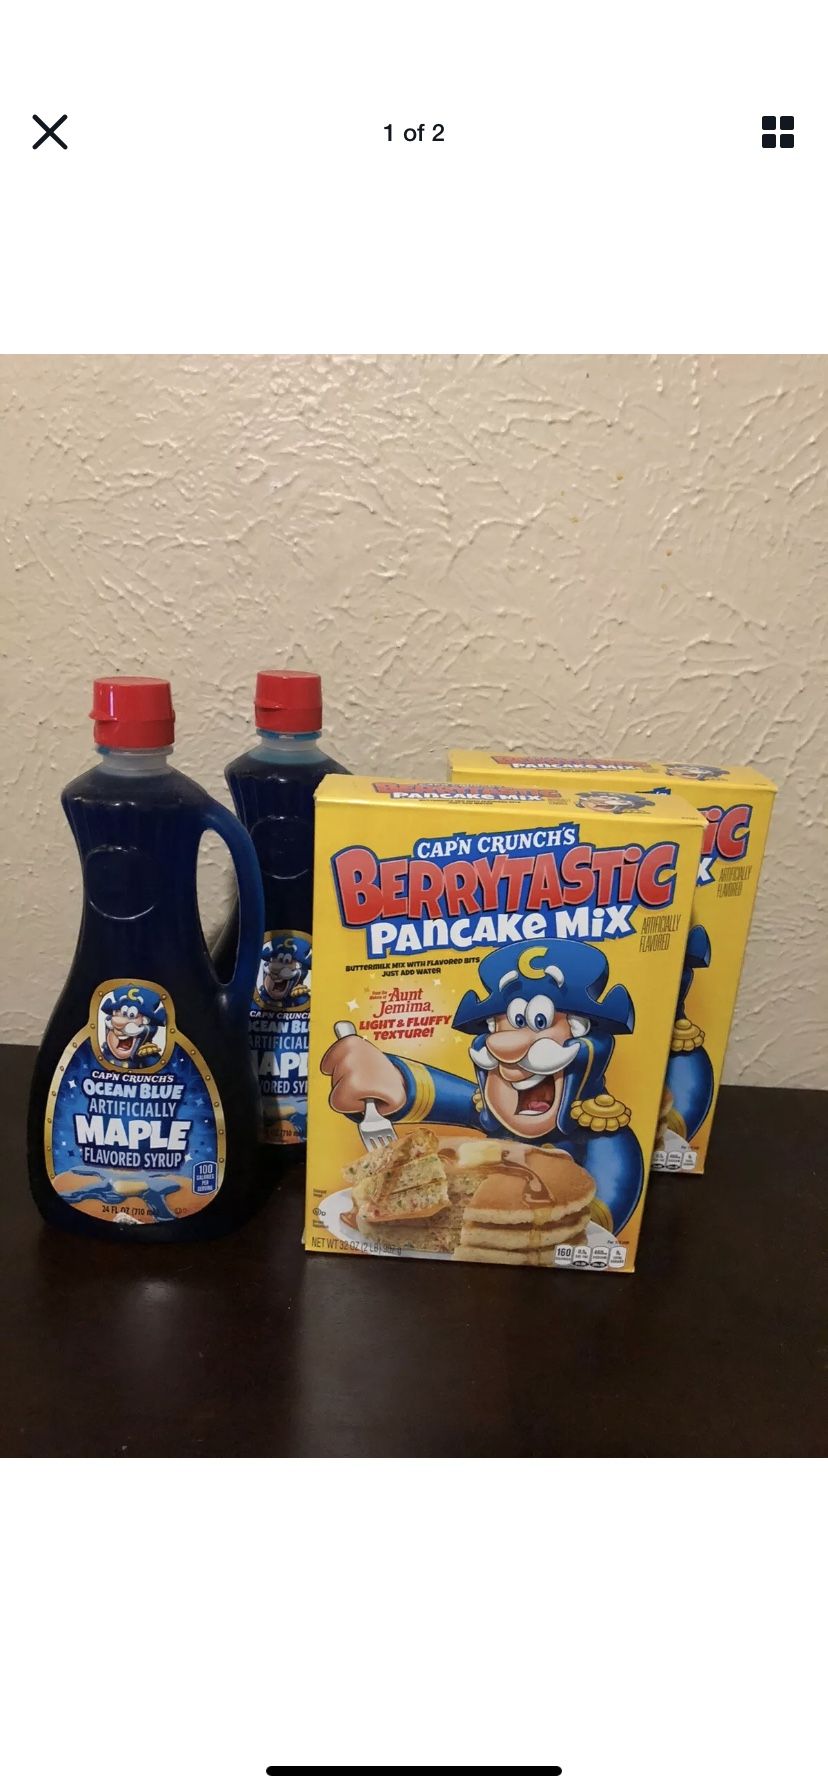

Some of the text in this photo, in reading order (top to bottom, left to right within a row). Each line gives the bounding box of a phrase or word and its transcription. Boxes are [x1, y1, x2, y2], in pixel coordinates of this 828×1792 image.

[417, 827, 576, 859] CAP'N CRUNCH'S
[640, 914, 682, 935] ARTIFICIALLY
[639, 933, 671, 953] FLAVORED
[388, 987, 423, 1002] Aunt
[372, 1001, 432, 1018] Jemima
[359, 1015, 453, 1030] LIGHT & FLUFFY
[91, 1070, 174, 1083] CAP'N CRUNCH'S
[83, 1078, 184, 1100] OCEAN BLUE
[89, 1098, 177, 1117] ARTIFICIALLY
[75, 1115, 192, 1150] MAPLE
[84, 1147, 182, 1168] FLAVORED SYRUP
[199, 1164, 213, 1175] 100
[102, 1205, 111, 1213] 24
[111, 1206, 119, 1214] FL
[121, 1207, 130, 1215] OZ
[312, 1237, 325, 1248] NET
[326, 1238, 339, 1249] WT
[340, 1240, 349, 1250] 32
[350, 1241, 359, 1251] OZ
[557, 1248, 571, 1257] 160
